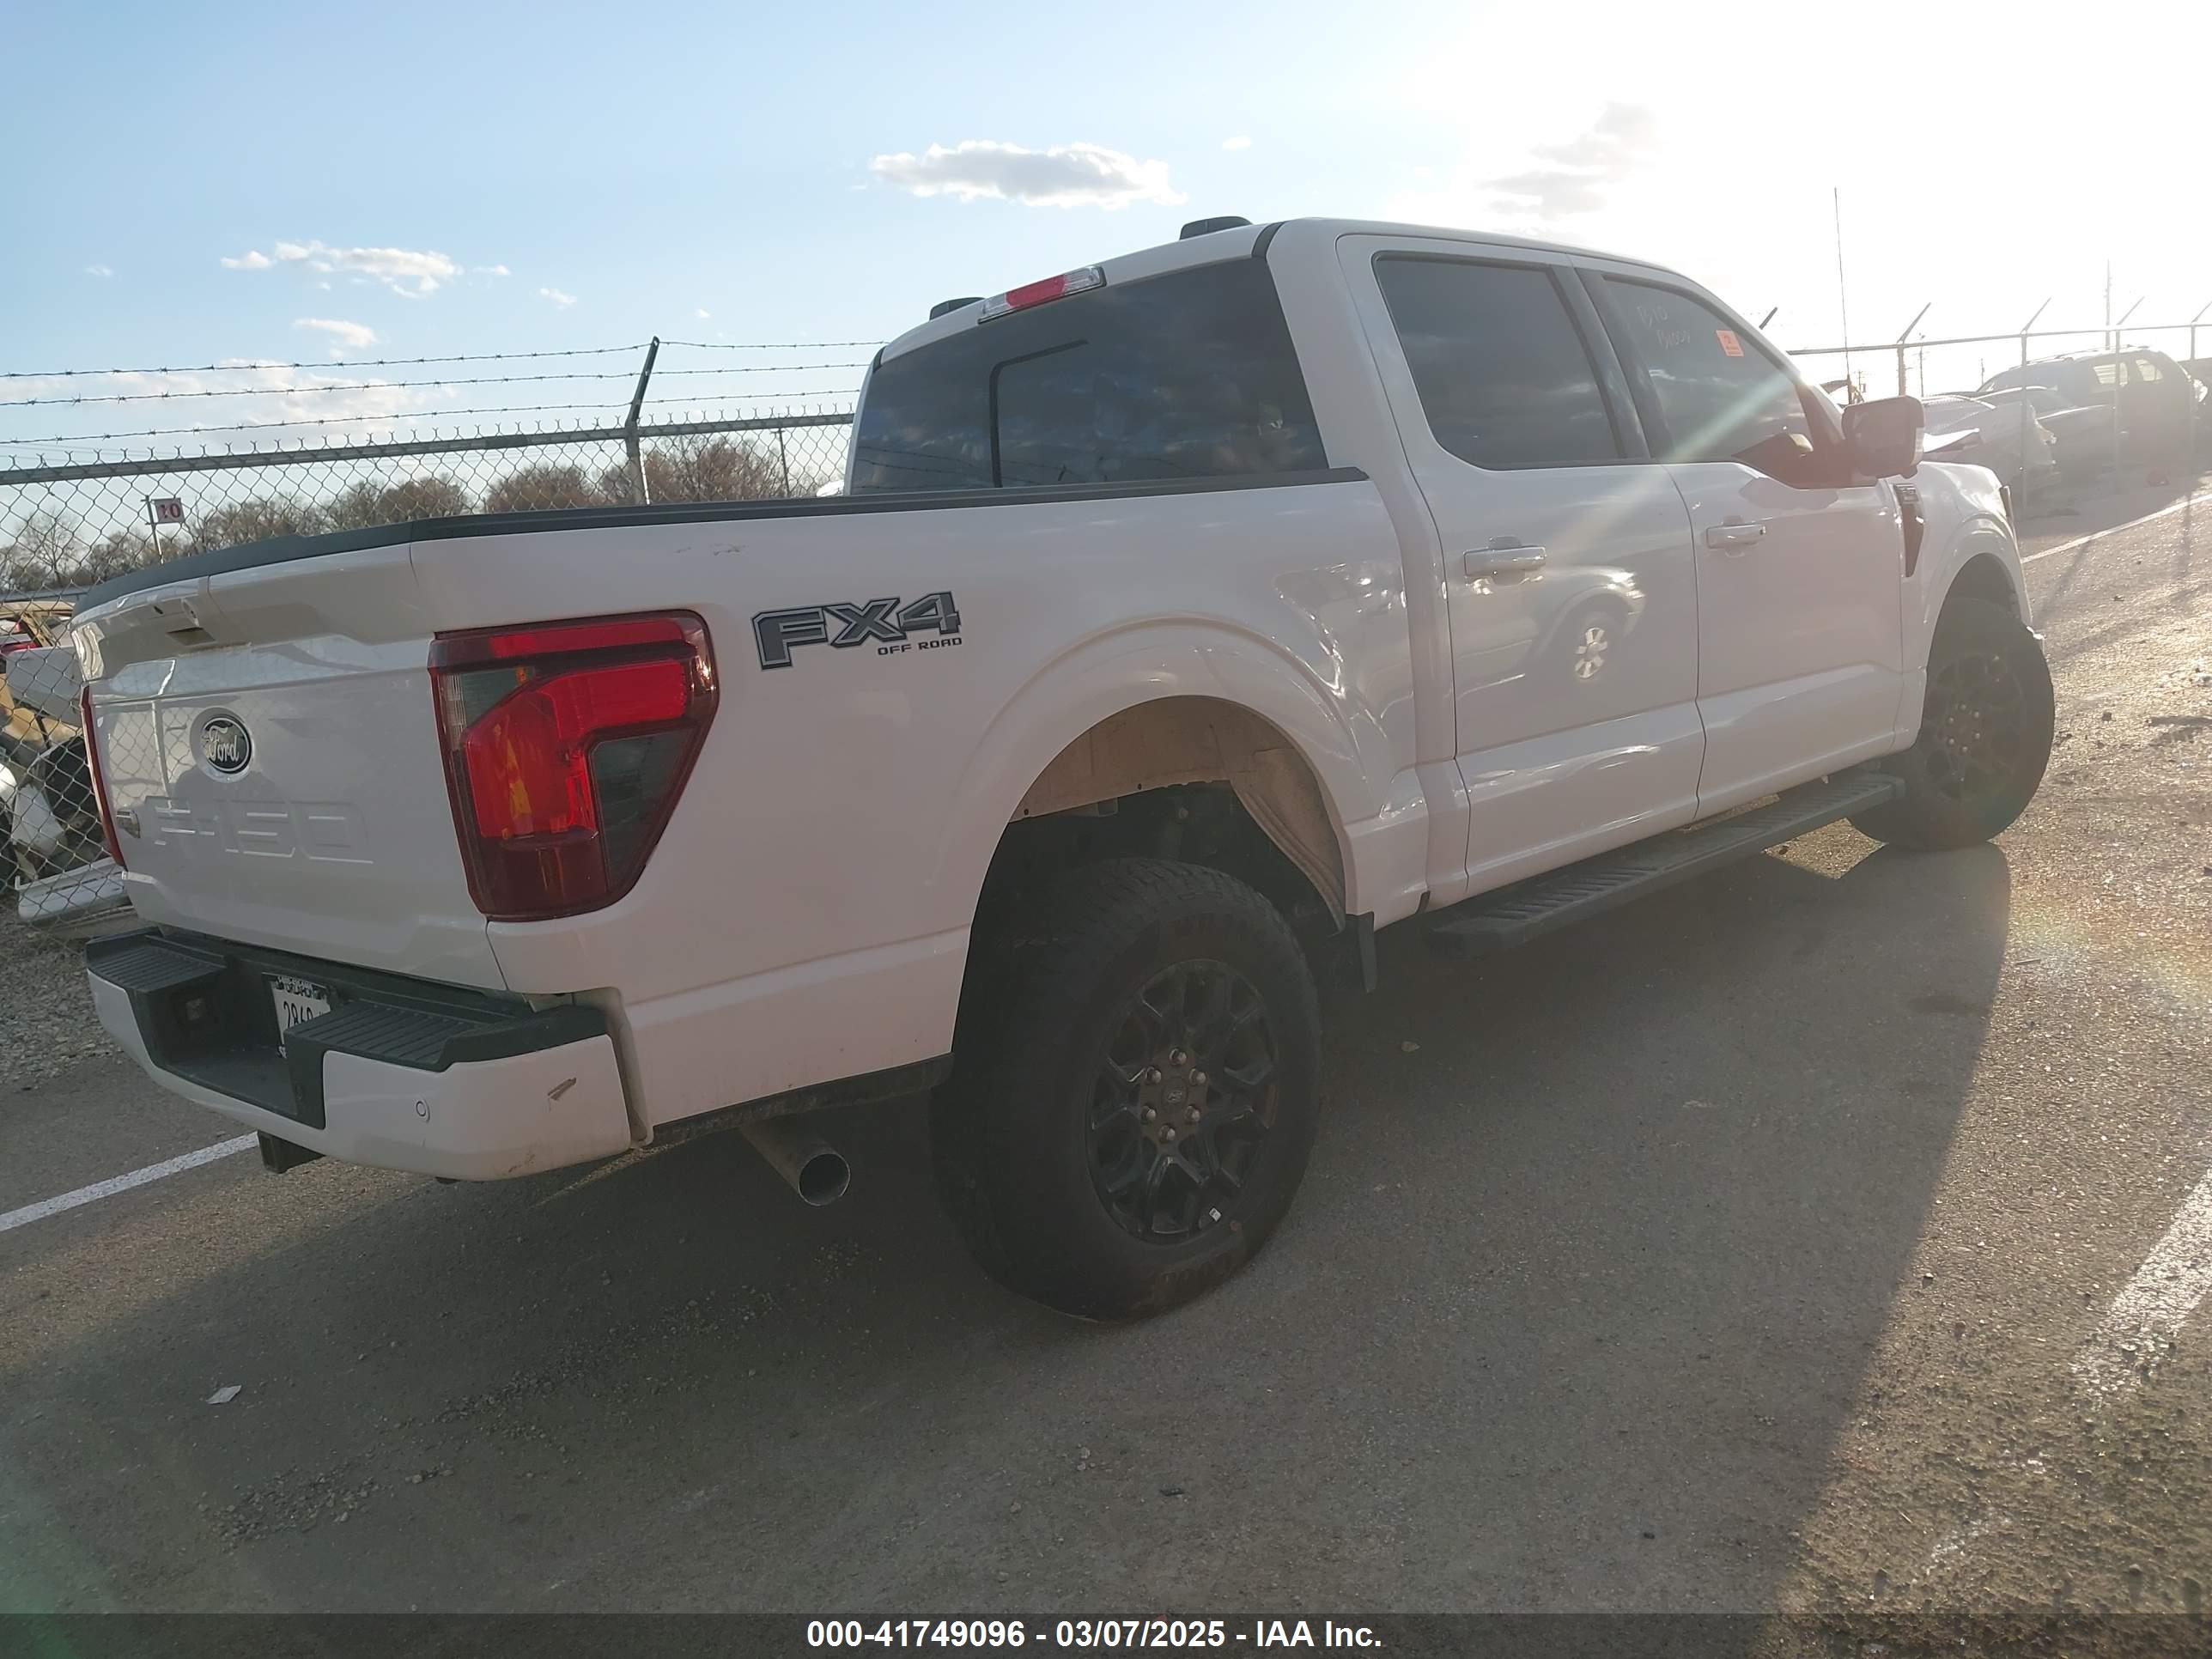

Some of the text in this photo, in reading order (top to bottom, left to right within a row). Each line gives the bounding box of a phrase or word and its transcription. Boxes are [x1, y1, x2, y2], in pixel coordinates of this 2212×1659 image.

[751, 591, 961, 670] FX4
[878, 636, 963, 655] OFF ROAD
[203, 725, 240, 763] Ford
